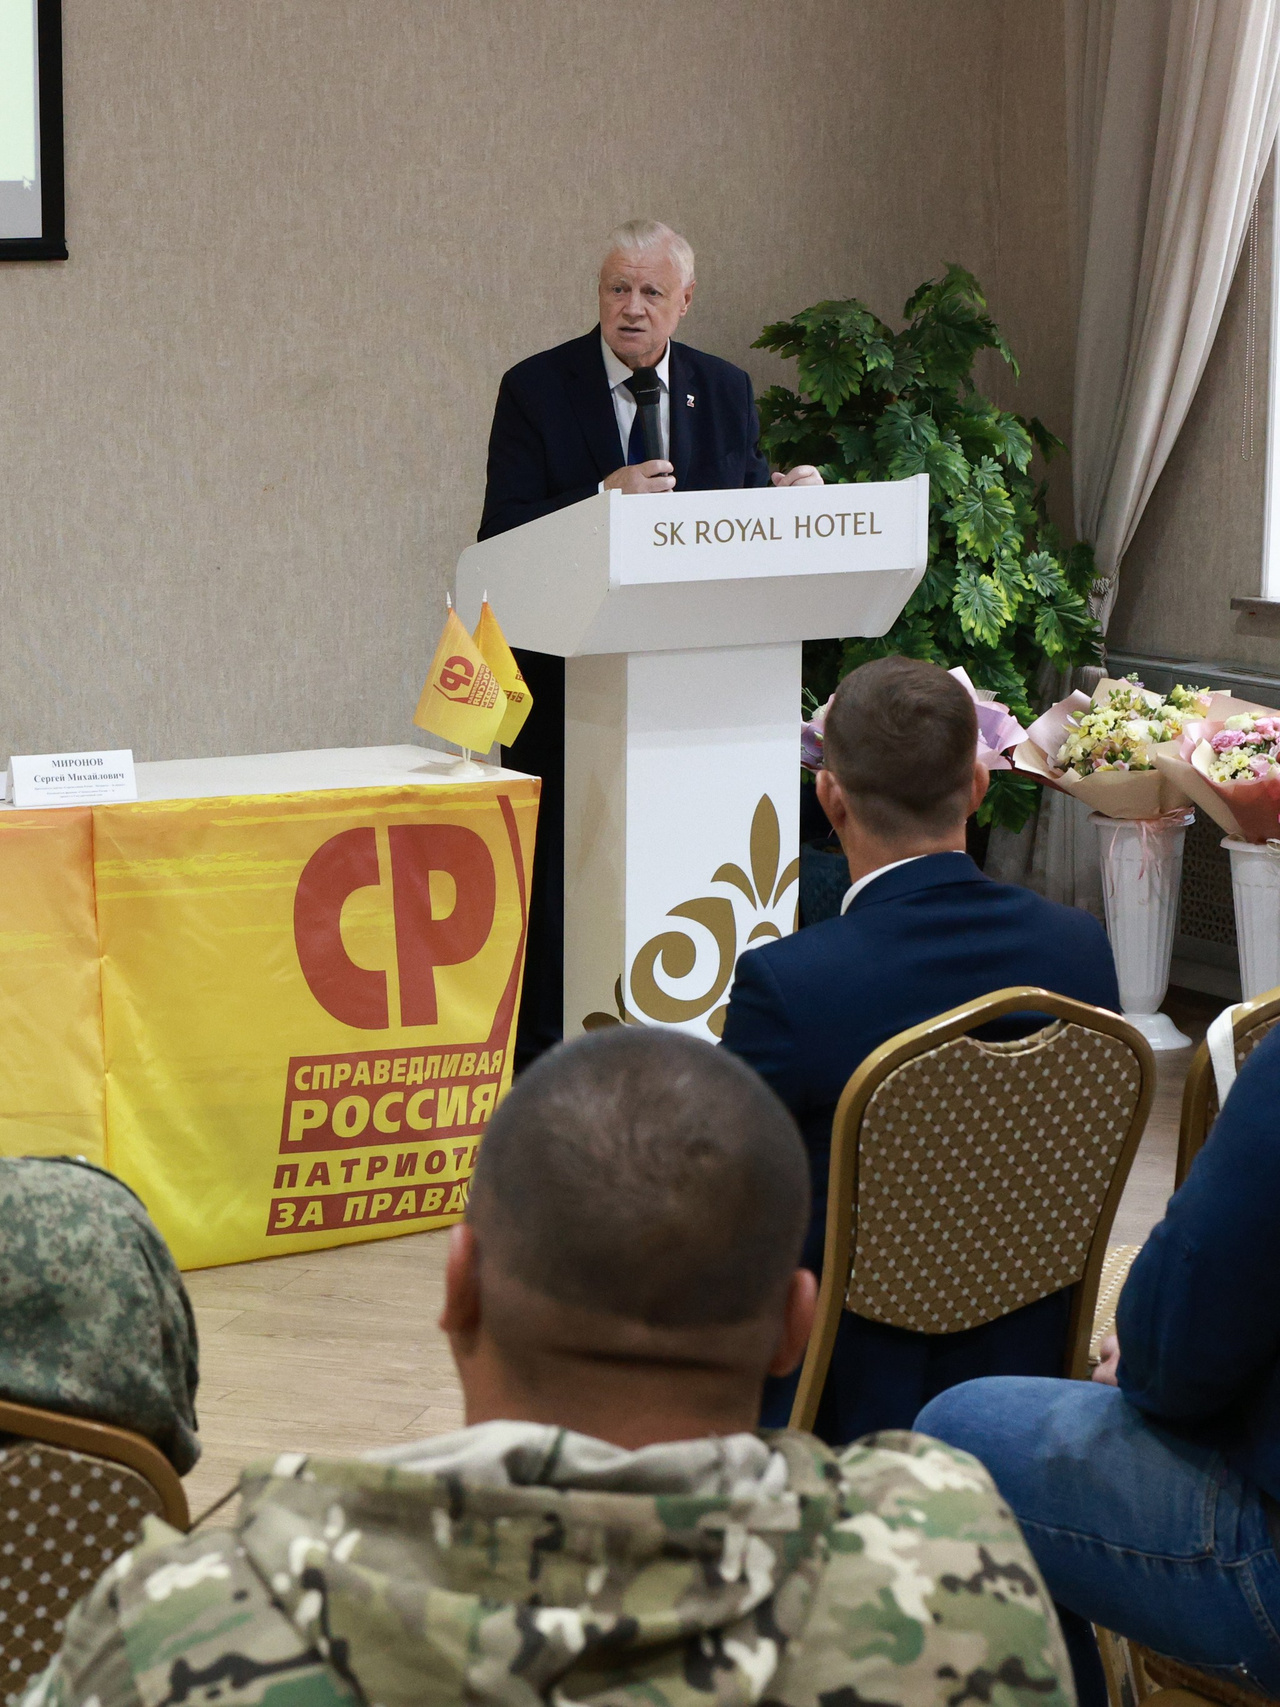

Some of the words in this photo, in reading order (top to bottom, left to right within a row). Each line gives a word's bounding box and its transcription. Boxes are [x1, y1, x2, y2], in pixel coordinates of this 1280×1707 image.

[653, 521, 686, 547] SK
[695, 517, 782, 544] ROYAL
[794, 511, 883, 539] HOTEL
[33, 773, 65, 784] Сергей
[68, 771, 125, 783] Михайлович
[52, 758, 104, 768] МИРОНОВ
[294, 1049, 504, 1092] СПРАВЕДЛИВАЯ
[287, 1082, 498, 1142] РОССИЯ
[274, 1201, 324, 1229] ЗА
[343, 1182, 469, 1223] ПРАВД
